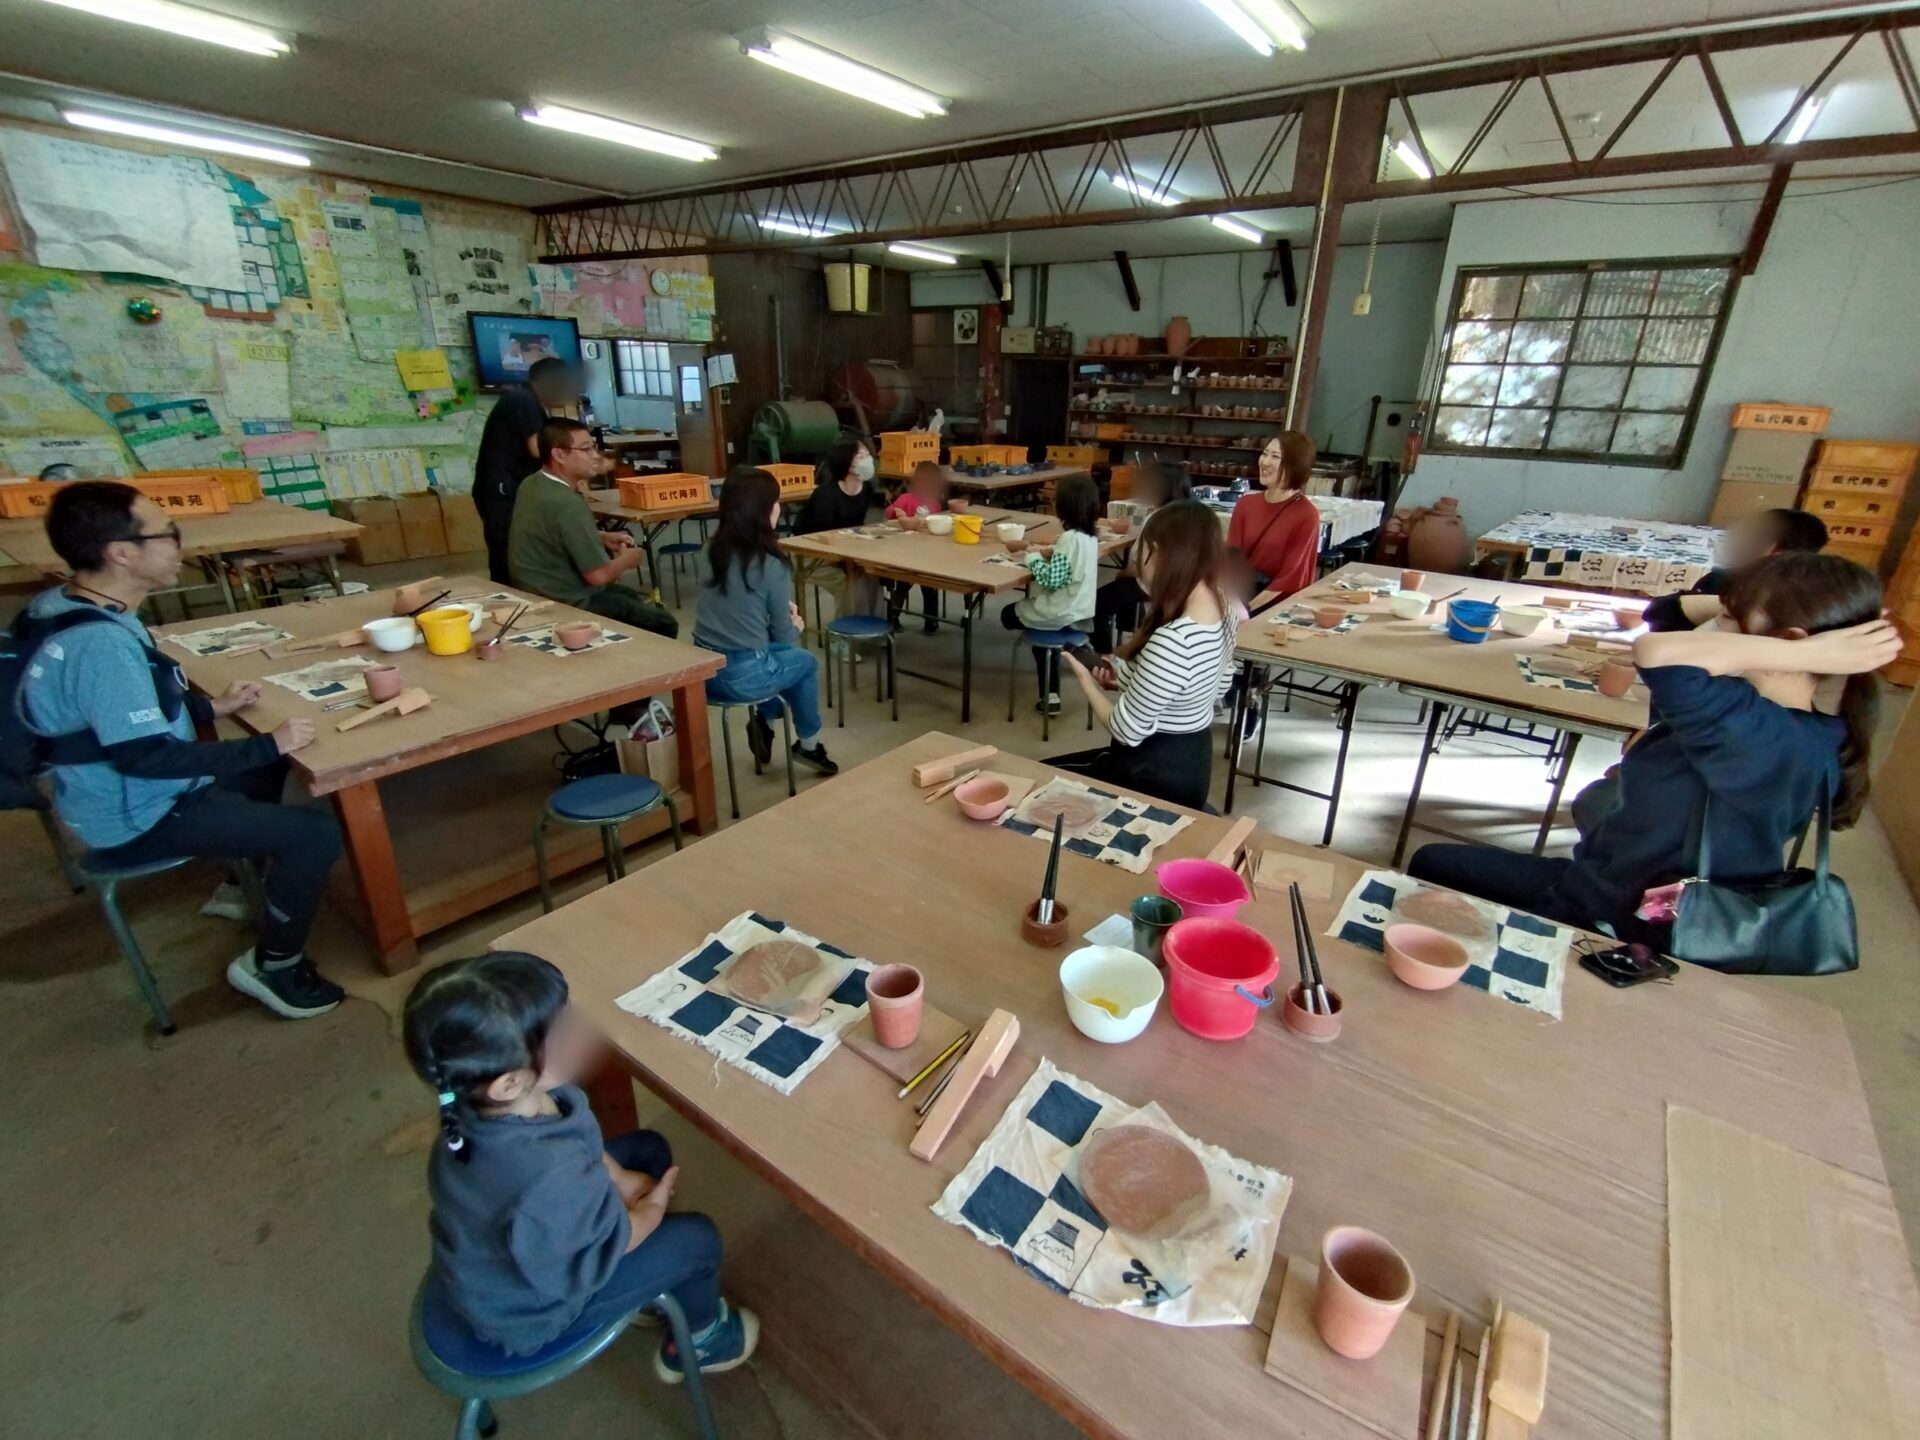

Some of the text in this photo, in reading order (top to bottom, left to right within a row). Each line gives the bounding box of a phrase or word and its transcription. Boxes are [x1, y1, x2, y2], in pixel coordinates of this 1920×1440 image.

[1754, 413, 1808, 426] 松代陶苑
[1832, 475, 1889, 488] 松代陶苑
[150, 494, 204, 508] 代陶苑
[659, 488, 698, 501] 松代陶苑
[1830, 526, 1872, 537] 代陶苑
